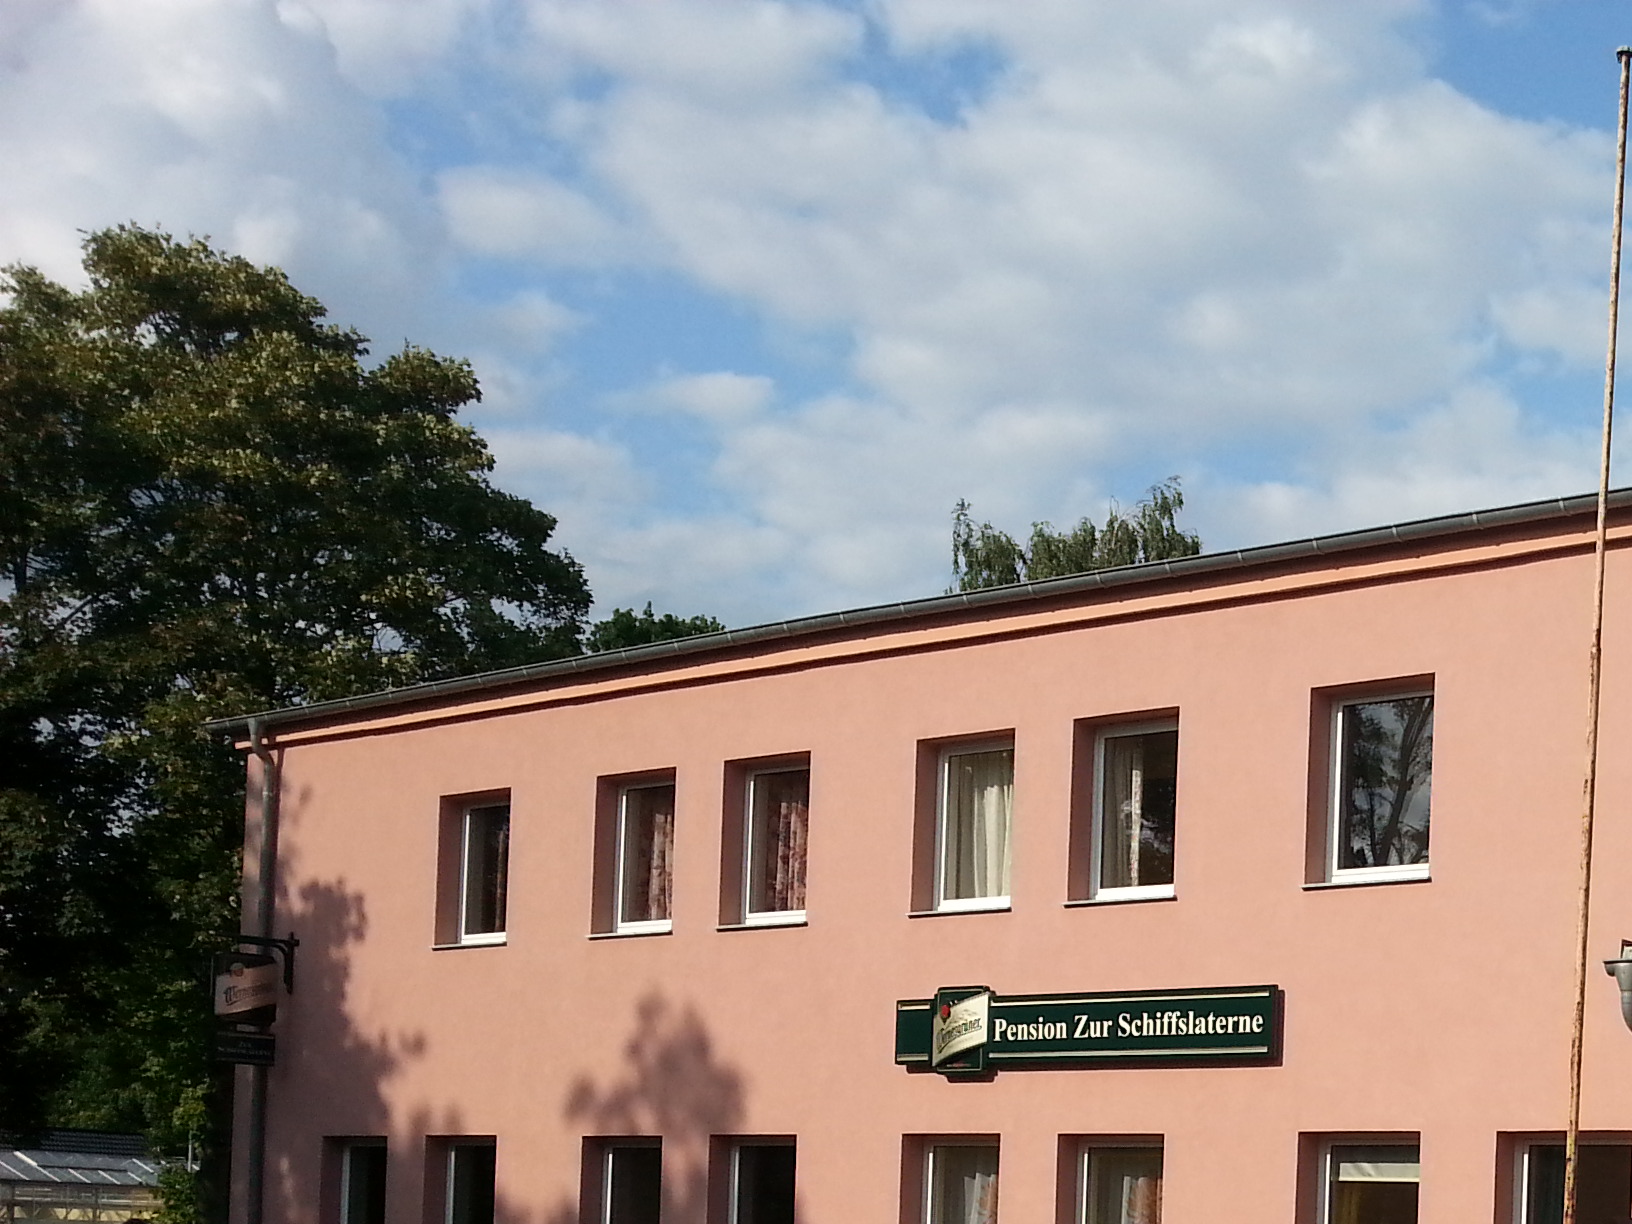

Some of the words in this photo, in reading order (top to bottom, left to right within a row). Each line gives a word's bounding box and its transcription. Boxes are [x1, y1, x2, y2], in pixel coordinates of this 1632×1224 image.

[993, 1017, 1067, 1042] Pension
[1073, 1014, 1113, 1039] Zur
[1117, 1010, 1264, 1038] Schiffslaterne
